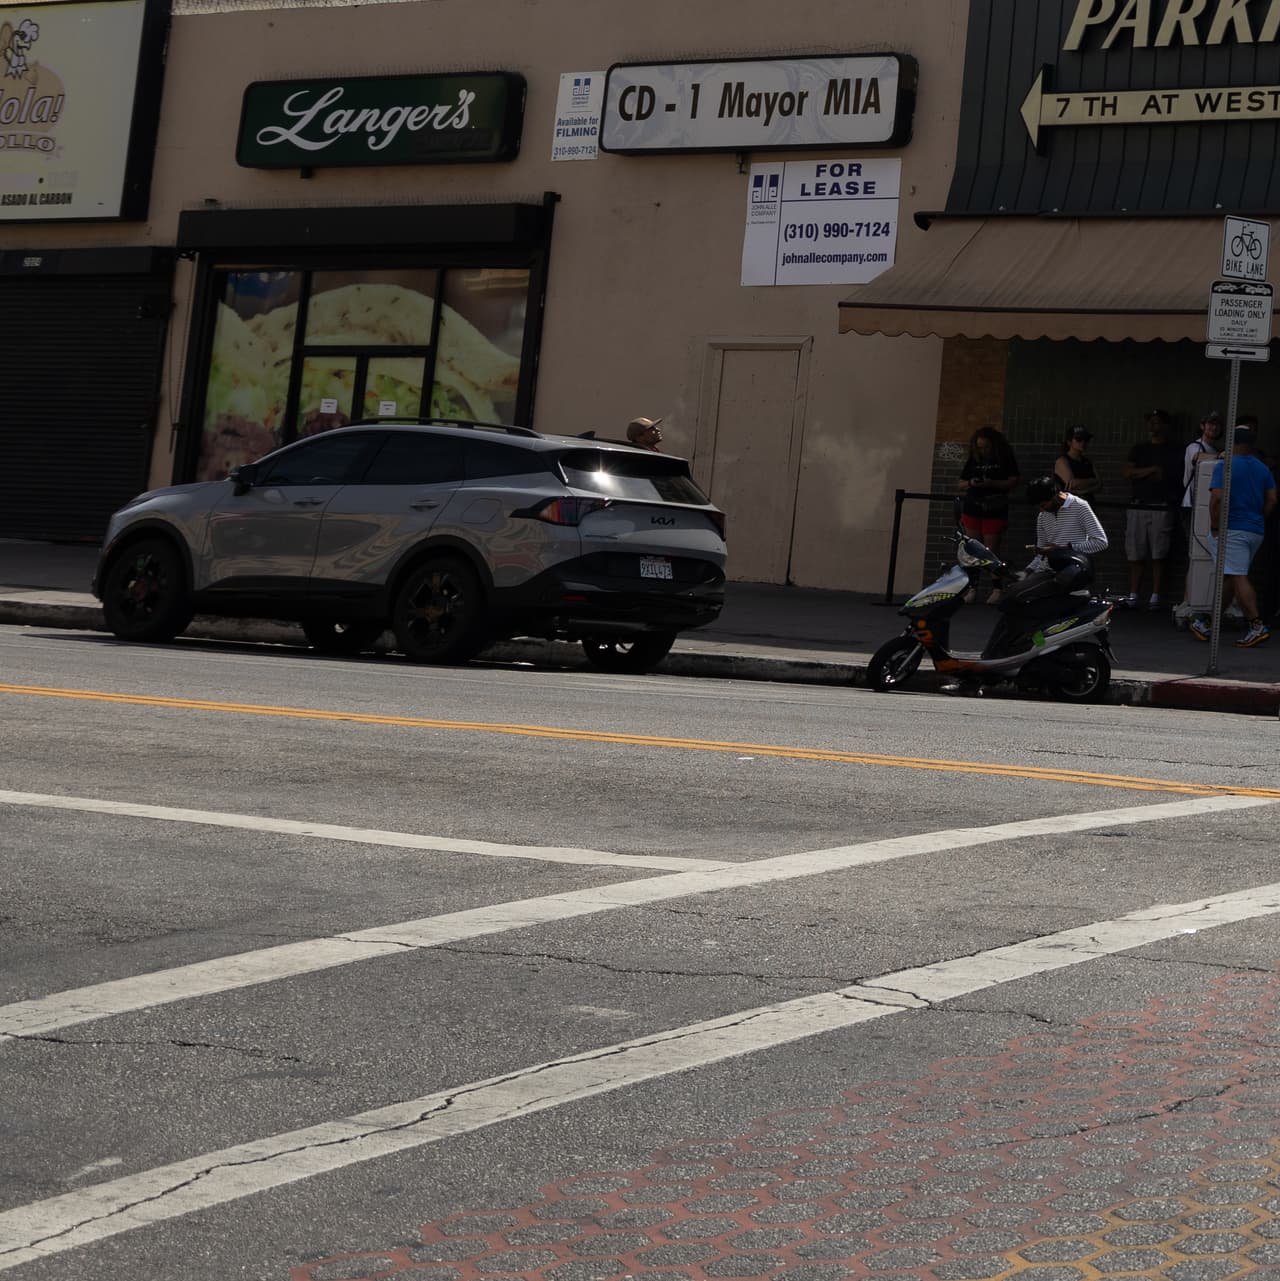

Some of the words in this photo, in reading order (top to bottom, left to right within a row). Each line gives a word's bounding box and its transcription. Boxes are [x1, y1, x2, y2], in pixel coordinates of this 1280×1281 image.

[0, 87, 64, 125] ola!
[619, 85, 656, 121] CD
[690, 84, 700, 119] 1
[718, 82, 808, 126] Mayor
[823, 77, 881, 116] MIA
[1056, 98, 1070, 118] 7
[1083, 95, 1118, 117] TH
[1141, 94, 1179, 115] AT
[256, 86, 477, 150] Langer's
[557, 117, 587, 126] Available
[556, 127, 597, 137] FILMING
[815, 163, 862, 177] FOR
[800, 181, 876, 196] LEASE
[784, 223, 819, 242] (310)
[823, 222, 890, 238] 990-7124
[782, 252, 887, 266] johnallecompany.com
[1226, 259, 1242, 272] BIKE
[1246, 261, 1264, 276] LANE
[1220, 298, 1262, 308] PASSENGER
[1215, 309, 1244, 318] LOADING
[1248, 310, 1266, 319] ONLY
